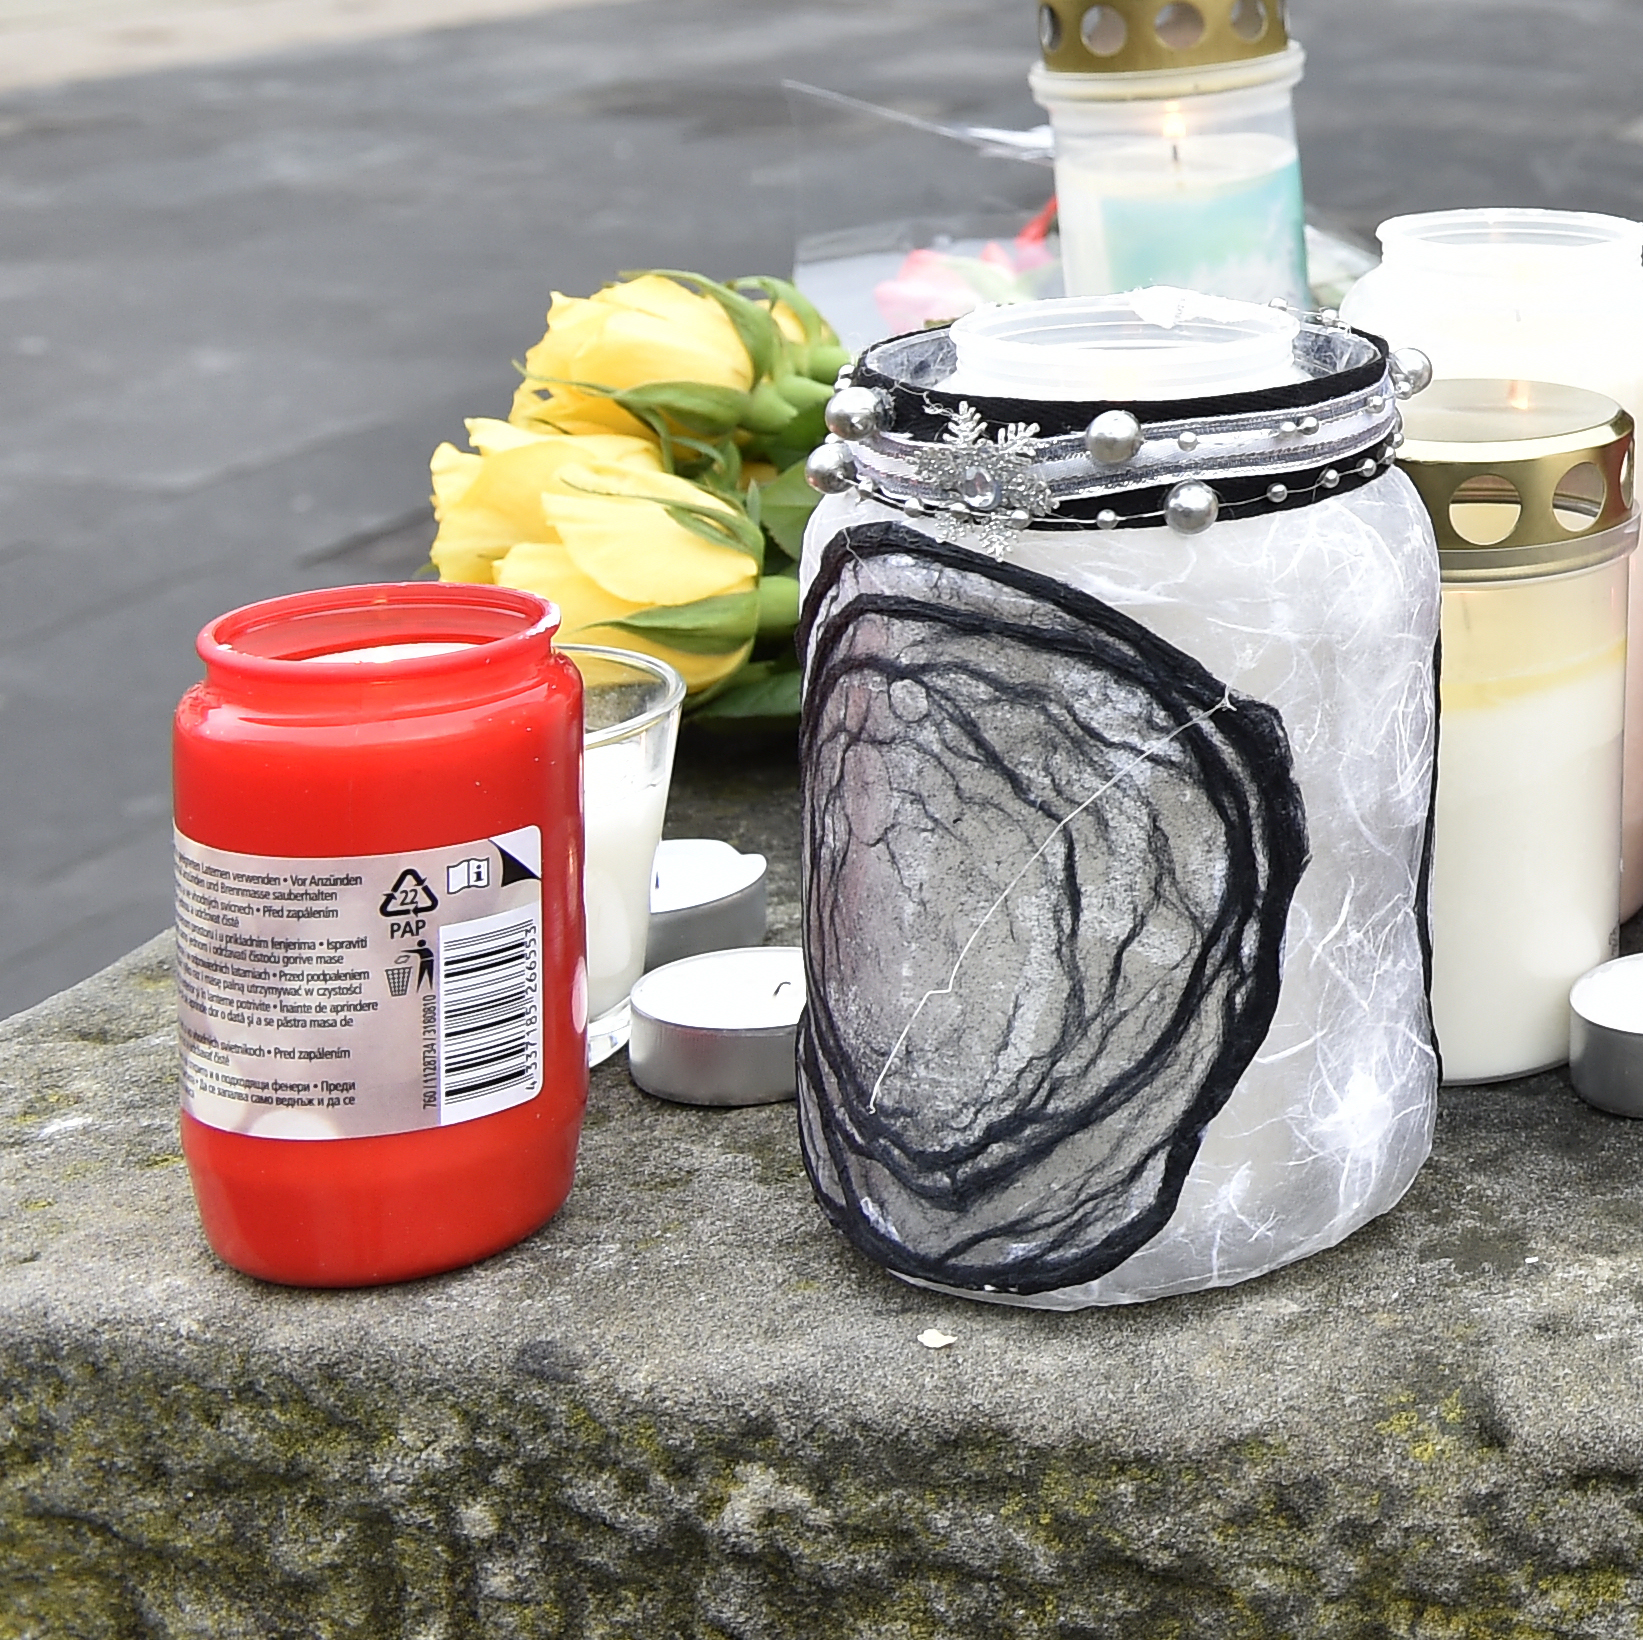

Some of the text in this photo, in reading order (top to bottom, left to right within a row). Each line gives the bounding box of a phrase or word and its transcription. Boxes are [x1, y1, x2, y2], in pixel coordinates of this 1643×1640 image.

[232, 872, 281, 886] verwenden
[290, 874, 308, 886] Vor
[206, 880, 219, 892] und
[220, 881, 271, 900] Brennmasse
[272, 889, 338, 901] sauberhalten
[400, 888, 418, 906] 22
[390, 919, 426, 939] PAP
[282, 953, 313, 967] gorive
[316, 955, 344, 964] mase
[524, 925, 538, 996] 266553
[279, 970, 304, 982] Przed
[306, 969, 370, 985] podpaleniem
[304, 988, 314, 996] w
[317, 983, 362, 999] czystości
[315, 1002, 328, 1014] de
[330, 999, 379, 1016] aprindere
[256, 1017, 262, 1026] a
[264, 1017, 275, 1027] se
[309, 1018, 338, 1028] masa
[340, 1015, 354, 1028] de
[524, 1004, 538, 1073] 337185
[274, 1047, 296, 1059] Pred
[298, 1047, 351, 1063] zapálením
[321, 1080, 356, 1095] Преди
[317, 1096, 325, 1106] и
[326, 1096, 341, 1108] да
[343, 1095, 355, 1106] се
[423, 1090, 437, 1110] 760
